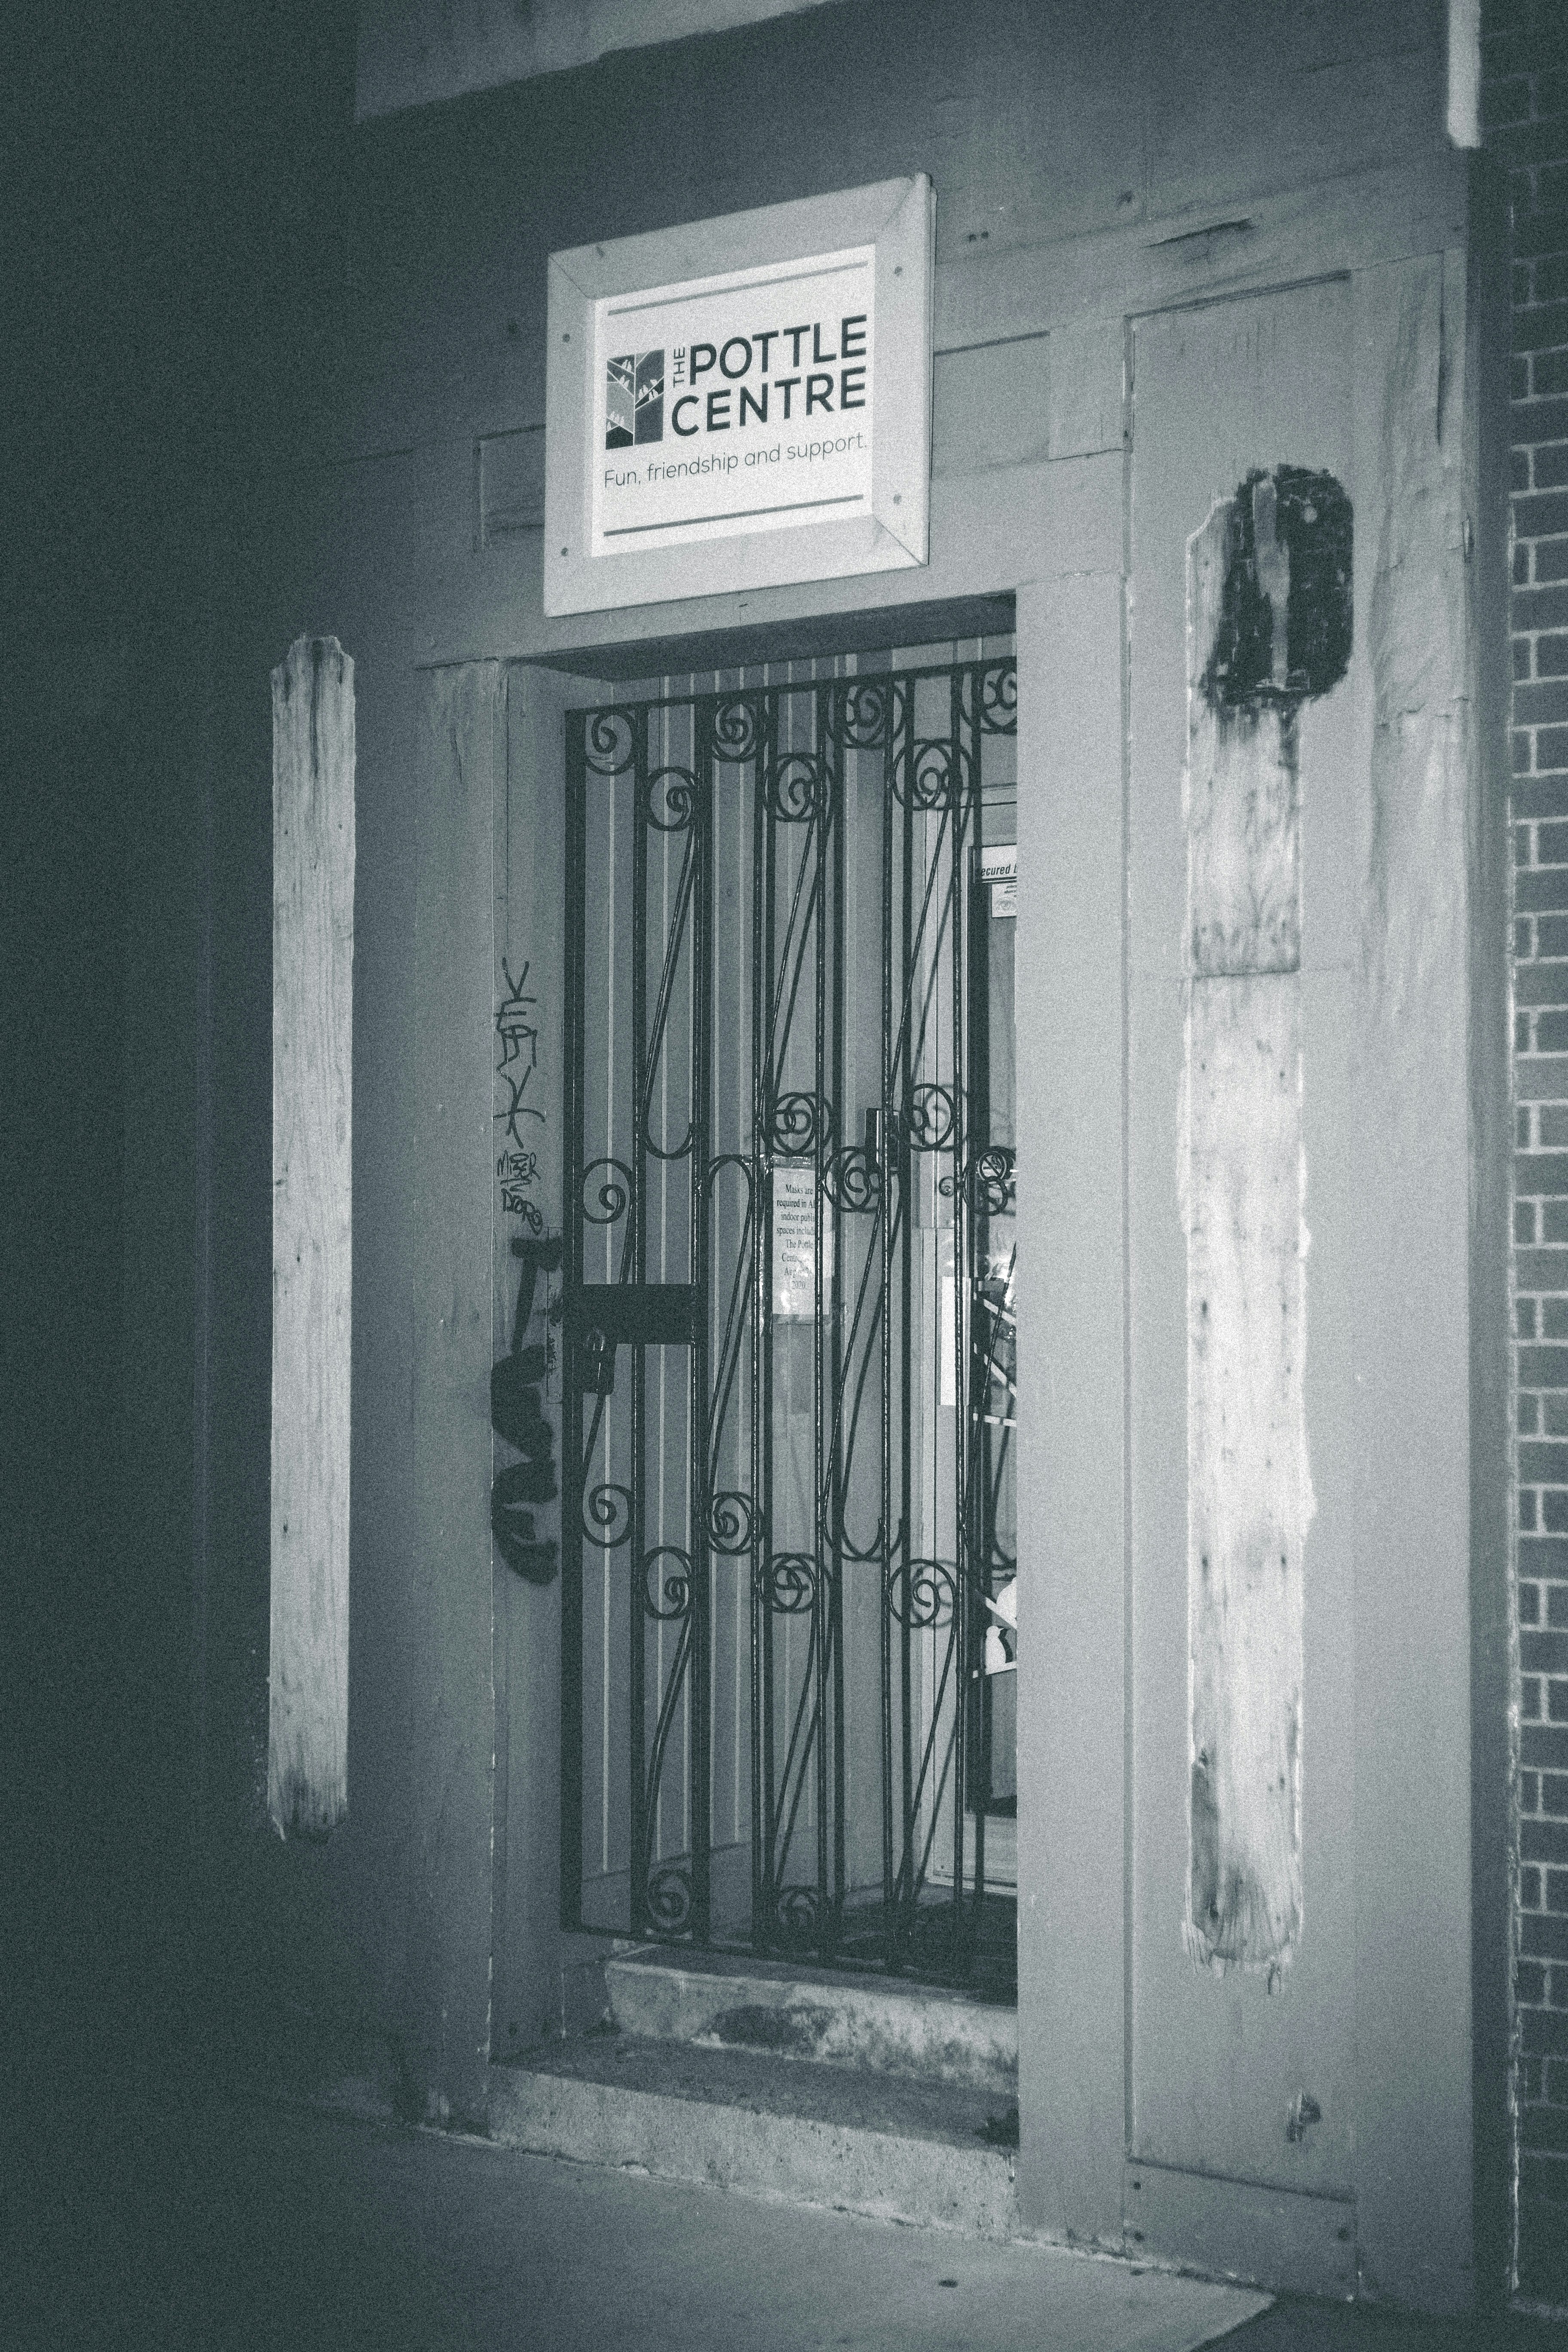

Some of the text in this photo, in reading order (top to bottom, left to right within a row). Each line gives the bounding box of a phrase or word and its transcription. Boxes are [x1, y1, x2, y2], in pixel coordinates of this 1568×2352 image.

[673, 314, 867, 388] THE POTTLE
[671, 366, 867, 437] CENTRE
[604, 432, 868, 488] Fun, friendship and support.
[980, 864, 1011, 876] ecured
[786, 1184, 803, 1194] Masks
[777, 1199, 800, 1209] required
[801, 1199, 806, 1208] in
[781, 1212, 815, 1224] indoor publi
[776, 1227, 795, 1236] spaces
[785, 1239, 796, 1248] The
